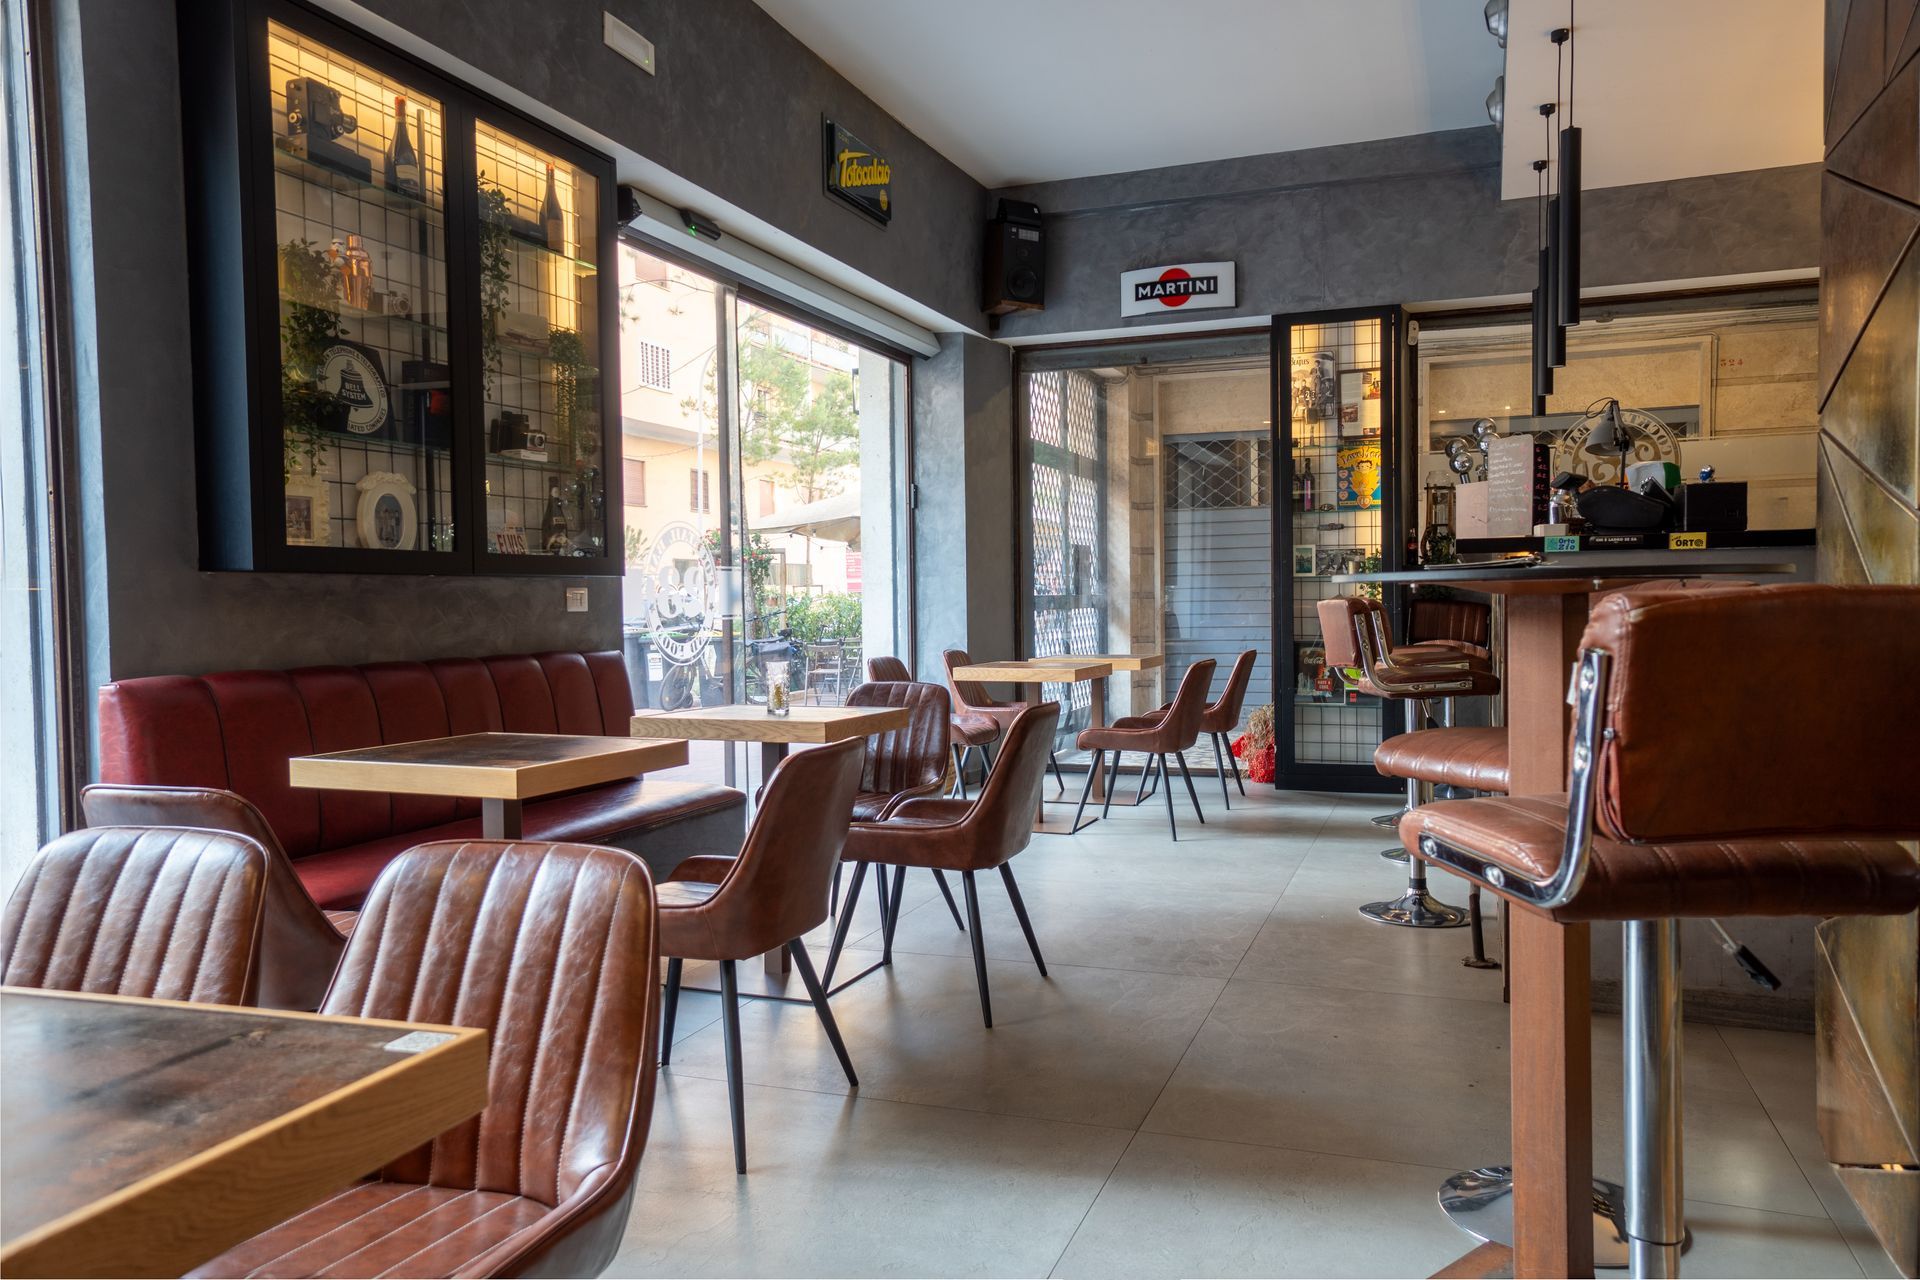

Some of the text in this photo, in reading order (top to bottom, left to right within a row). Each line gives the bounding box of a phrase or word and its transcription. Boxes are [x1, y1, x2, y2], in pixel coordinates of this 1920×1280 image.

[1138, 279, 1214, 298] MARTINI
[341, 389, 367, 400] SYSTEM
[344, 382, 362, 392] BELL
[496, 534, 526, 554] ELVIS
